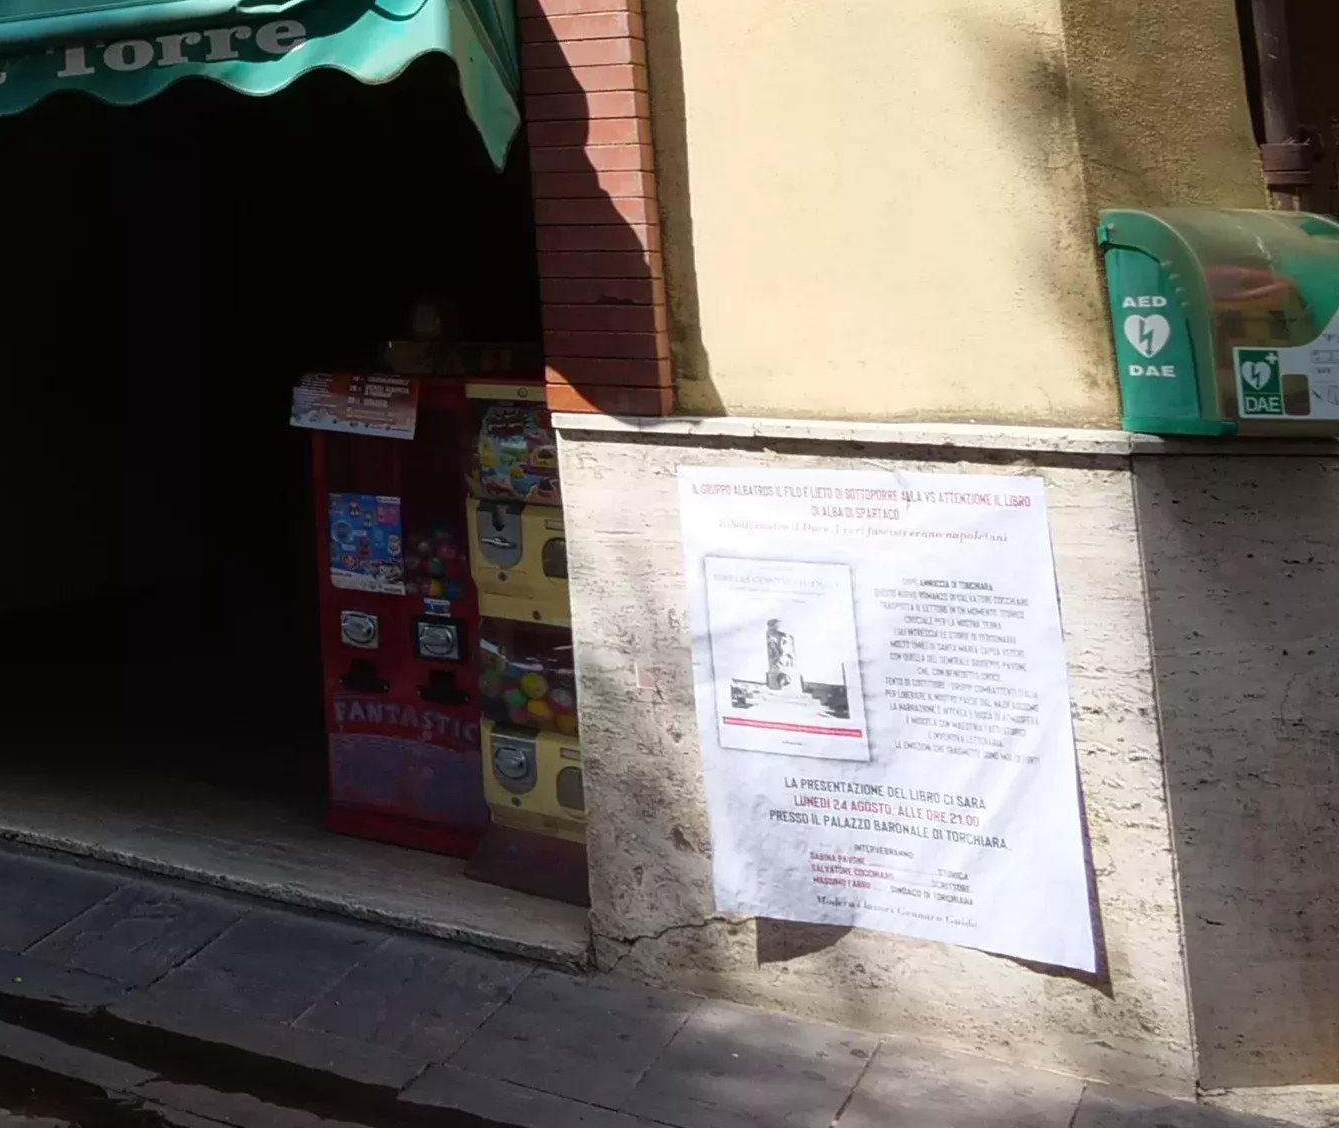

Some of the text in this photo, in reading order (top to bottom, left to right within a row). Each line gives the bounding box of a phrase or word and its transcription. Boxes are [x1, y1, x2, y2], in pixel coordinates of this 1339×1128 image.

[46, 18, 307, 79] Torre
[1122, 295, 1167, 308] AED
[1128, 365, 1176, 377] DAE
[1245, 396, 1282, 413] DAE
[701, 483, 731, 495] GRUPPO
[734, 484, 773, 496] ALBATROS
[784, 486, 802, 498] FILO
[810, 486, 832, 499] LIETO
[845, 488, 897, 502] SOTTOPORRE
[939, 492, 991, 506] ATTENZIONE
[1005, 495, 1031, 508] LIBRO
[822, 506, 843, 518] ALBA
[856, 507, 900, 520] SPARTACO
[333, 700, 478, 742] FANTASTIC
[785, 777, 797, 789] LA
[801, 778, 884, 796] PRESENTAZIONE
[887, 786, 907, 799] DEL
[909, 789, 940, 803] LIBRO
[943, 794, 954, 805] CI
[769, 810, 808, 824] PRESSO
[811, 813, 822, 825] IL
[824, 816, 871, 831] PALAZZO
[874, 820, 929, 839] BARONALE
[932, 829, 943, 840] DI
[833, 799, 847, 811] 24
[898, 805, 922, 819] ALLE
[926, 809, 948, 823] ORE
[950, 812, 979, 827] 21.00
